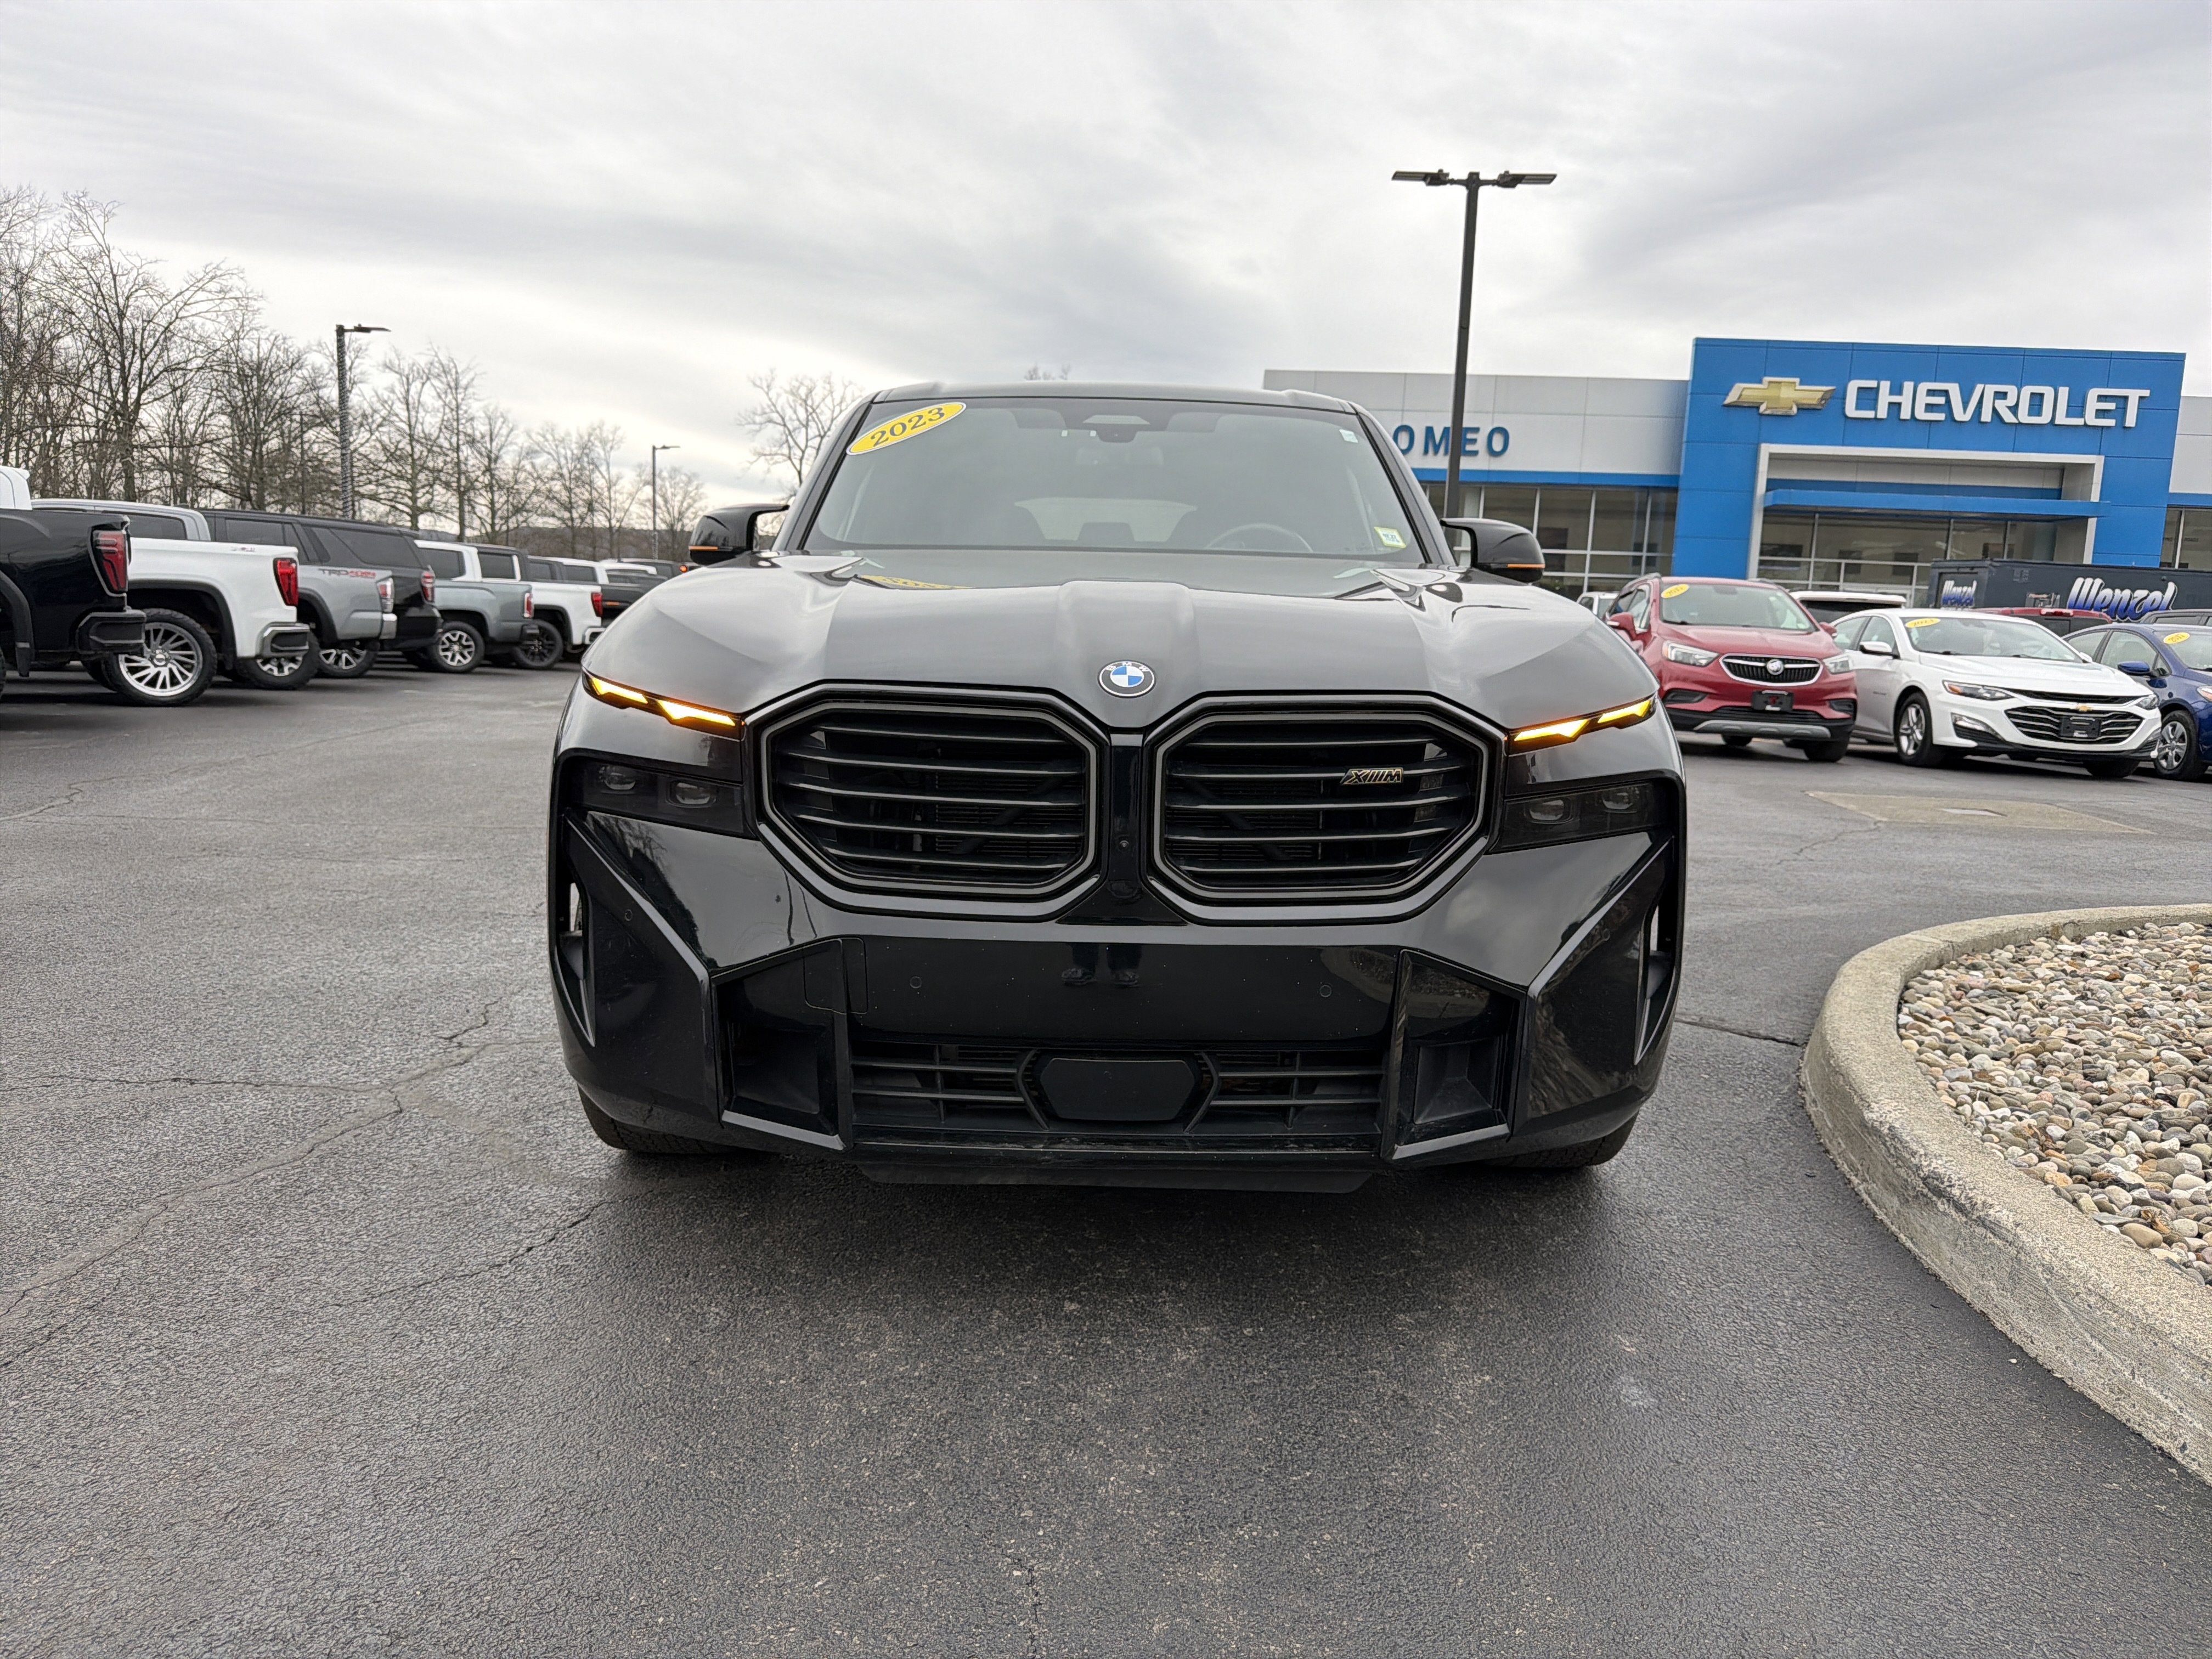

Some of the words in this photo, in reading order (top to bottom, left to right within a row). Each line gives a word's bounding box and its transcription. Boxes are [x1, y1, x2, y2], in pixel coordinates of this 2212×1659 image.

[1844, 379, 2151, 427] CHEVROLET
[870, 407, 945, 447] 2023
[1941, 580, 1977, 607] Wenzel
[2067, 577, 2178, 622] Wenzel
[1105, 662, 1149, 672] BMW
